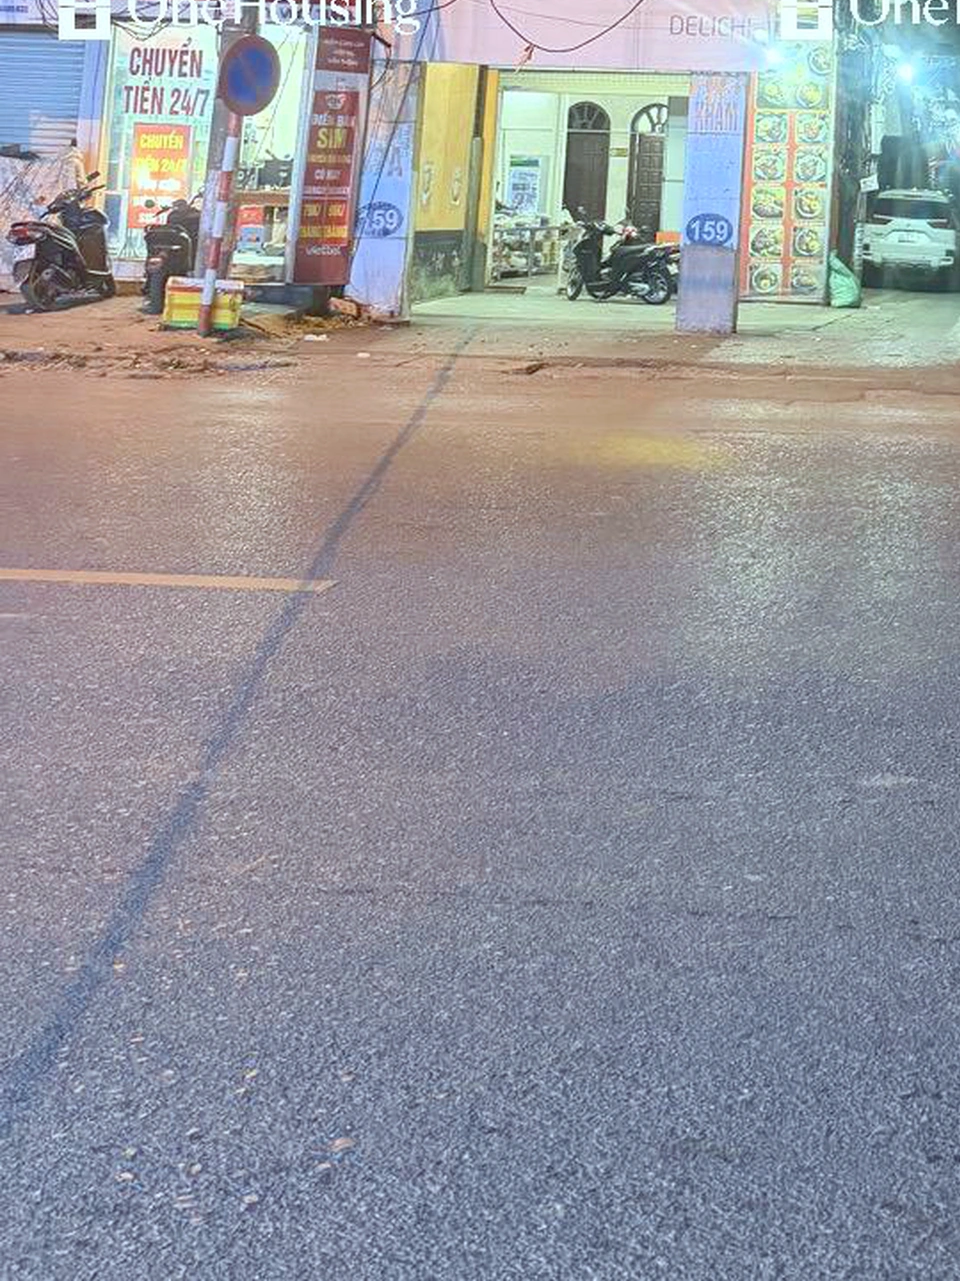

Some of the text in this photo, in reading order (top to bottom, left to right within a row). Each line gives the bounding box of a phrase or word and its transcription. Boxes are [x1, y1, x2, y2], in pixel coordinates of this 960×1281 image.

[129, 37, 203, 78] CHUYỂN
[169, 87, 210, 116] 24/7
[692, 220, 728, 241] 159
